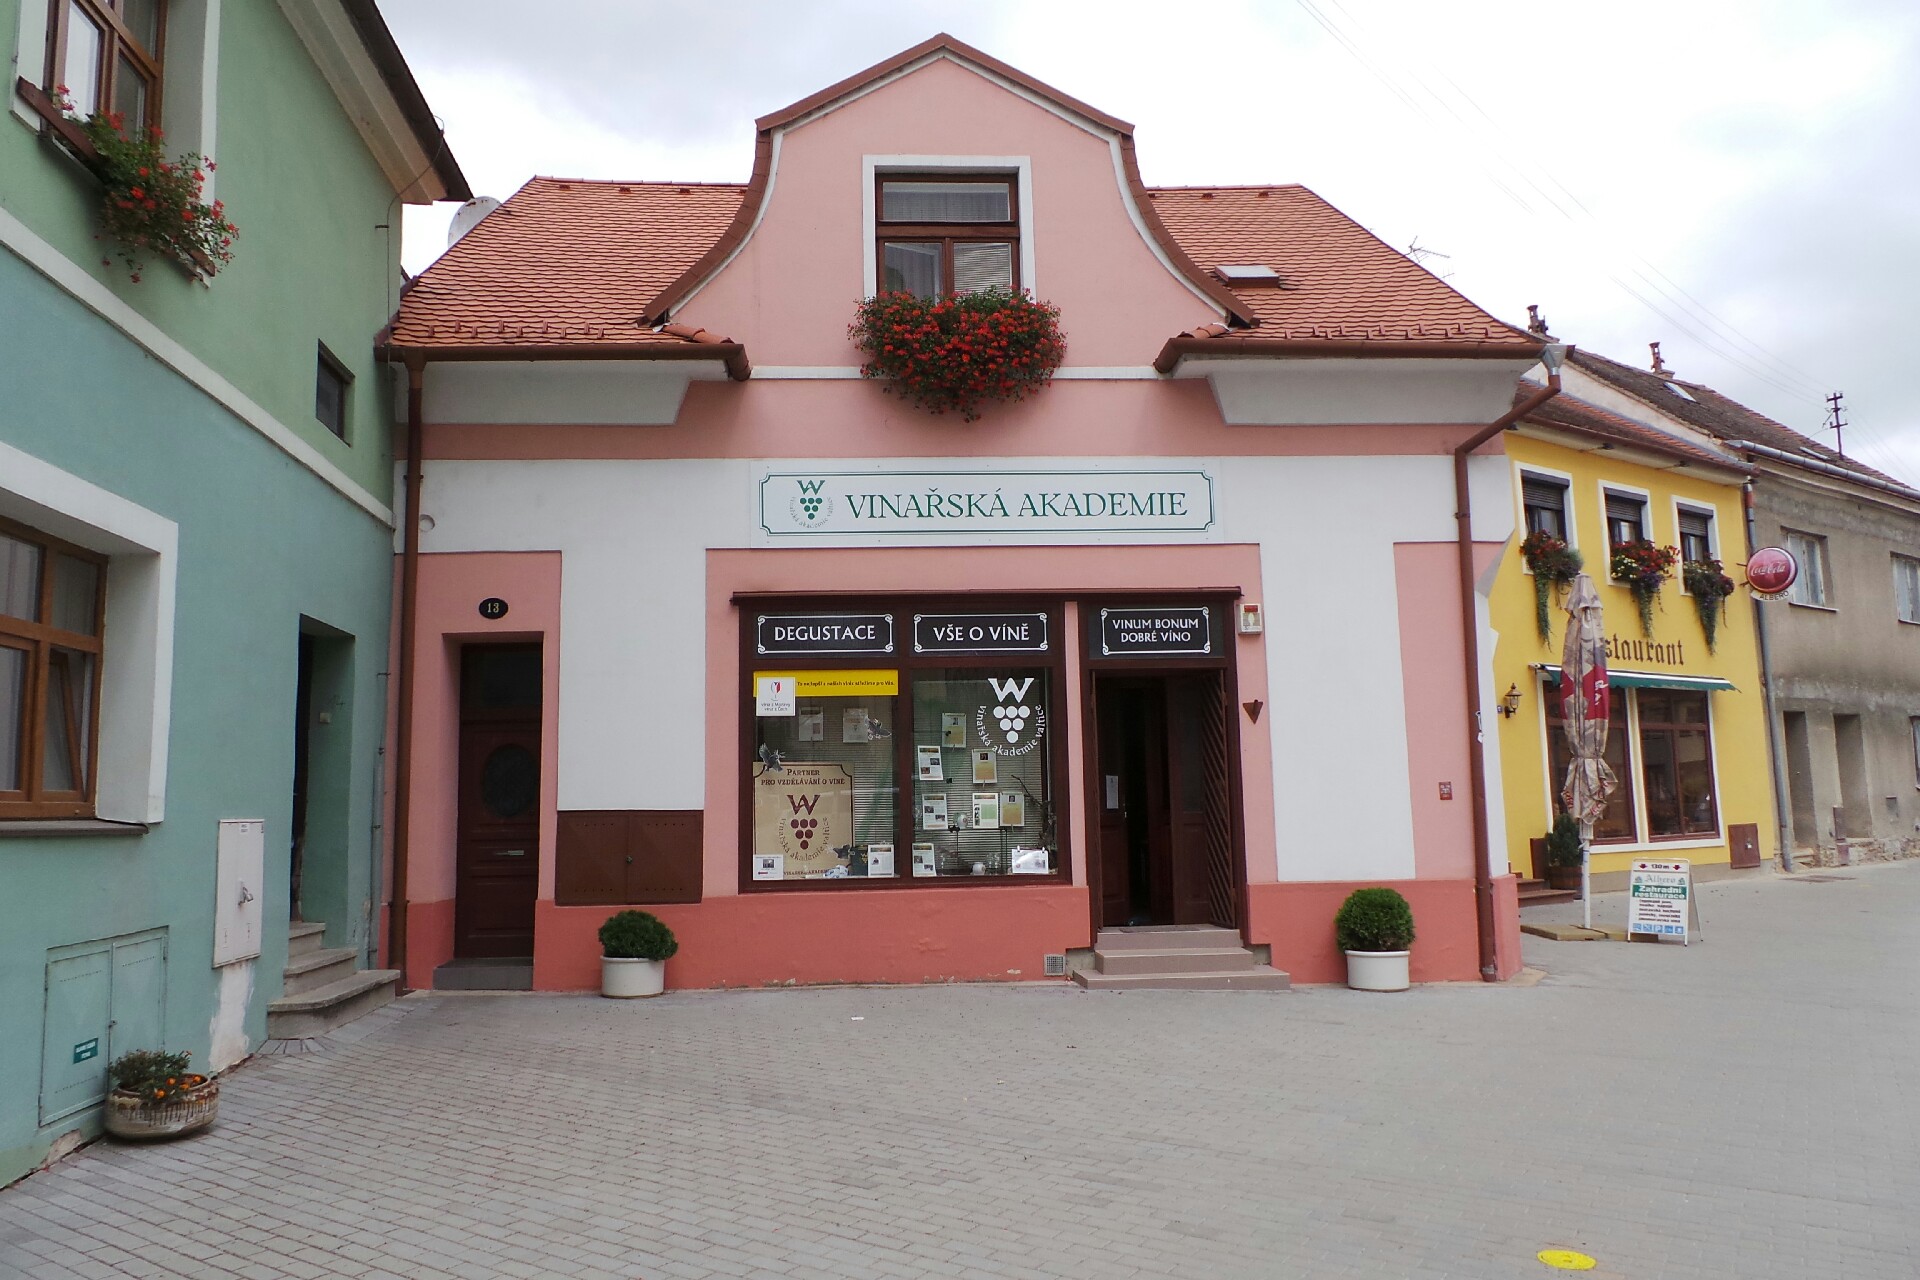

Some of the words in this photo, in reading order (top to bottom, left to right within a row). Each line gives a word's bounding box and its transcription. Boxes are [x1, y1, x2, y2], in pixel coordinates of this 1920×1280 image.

[844, 487, 1010, 519] VINAŘSKÁ
[1017, 492, 1188, 517] AKADEMIE
[1760, 590, 1789, 600] ALBERO
[487, 602, 500, 613] 13
[1112, 619, 1152, 629] VINUM
[1155, 618, 1199, 629] BONUM
[774, 625, 876, 641] DEGUSTACE
[933, 623, 964, 641] VŠE
[969, 626, 984, 641] O
[988, 622, 1030, 641] VÍNĚ
[1121, 630, 1158, 642] DOBRÉ
[1160, 630, 1191, 642] VÍNO
[1605, 633, 1684, 666] staurant
[976, 705, 993, 747] vinařská
[991, 738, 1038, 757] akademie
[1634, 891, 1686, 899] restaurace
